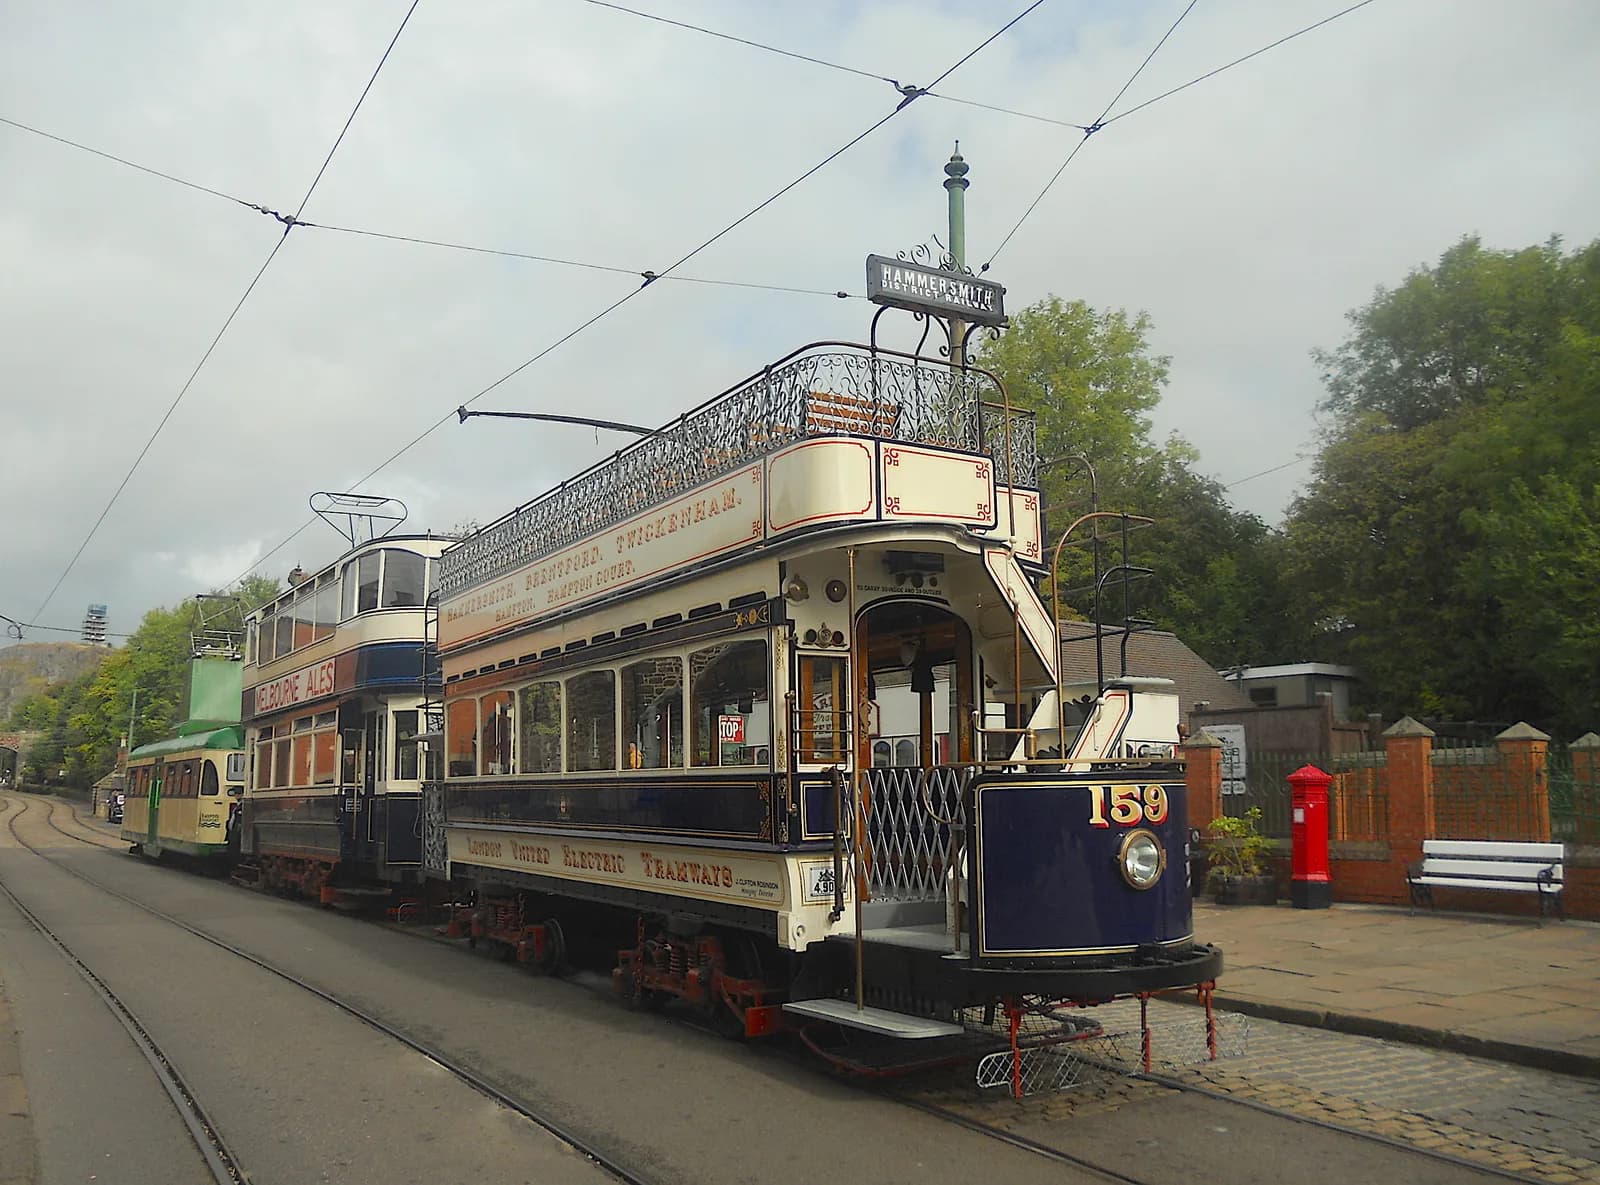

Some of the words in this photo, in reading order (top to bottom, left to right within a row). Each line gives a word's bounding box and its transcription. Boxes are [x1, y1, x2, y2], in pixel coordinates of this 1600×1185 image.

[881, 279, 938, 300] DISTRICT
[945, 294, 993, 312] RAILWAY
[883, 267, 993, 305] HAMMERSMITH
[256, 674, 300, 711] MELBOURNE
[305, 662, 334, 698] ALES
[1088, 783, 1169, 829] 159
[510, 839, 550, 865] UNITED
[562, 844, 626, 874] ELECTRIC
[640, 851, 733, 888] TRAMWAYS
